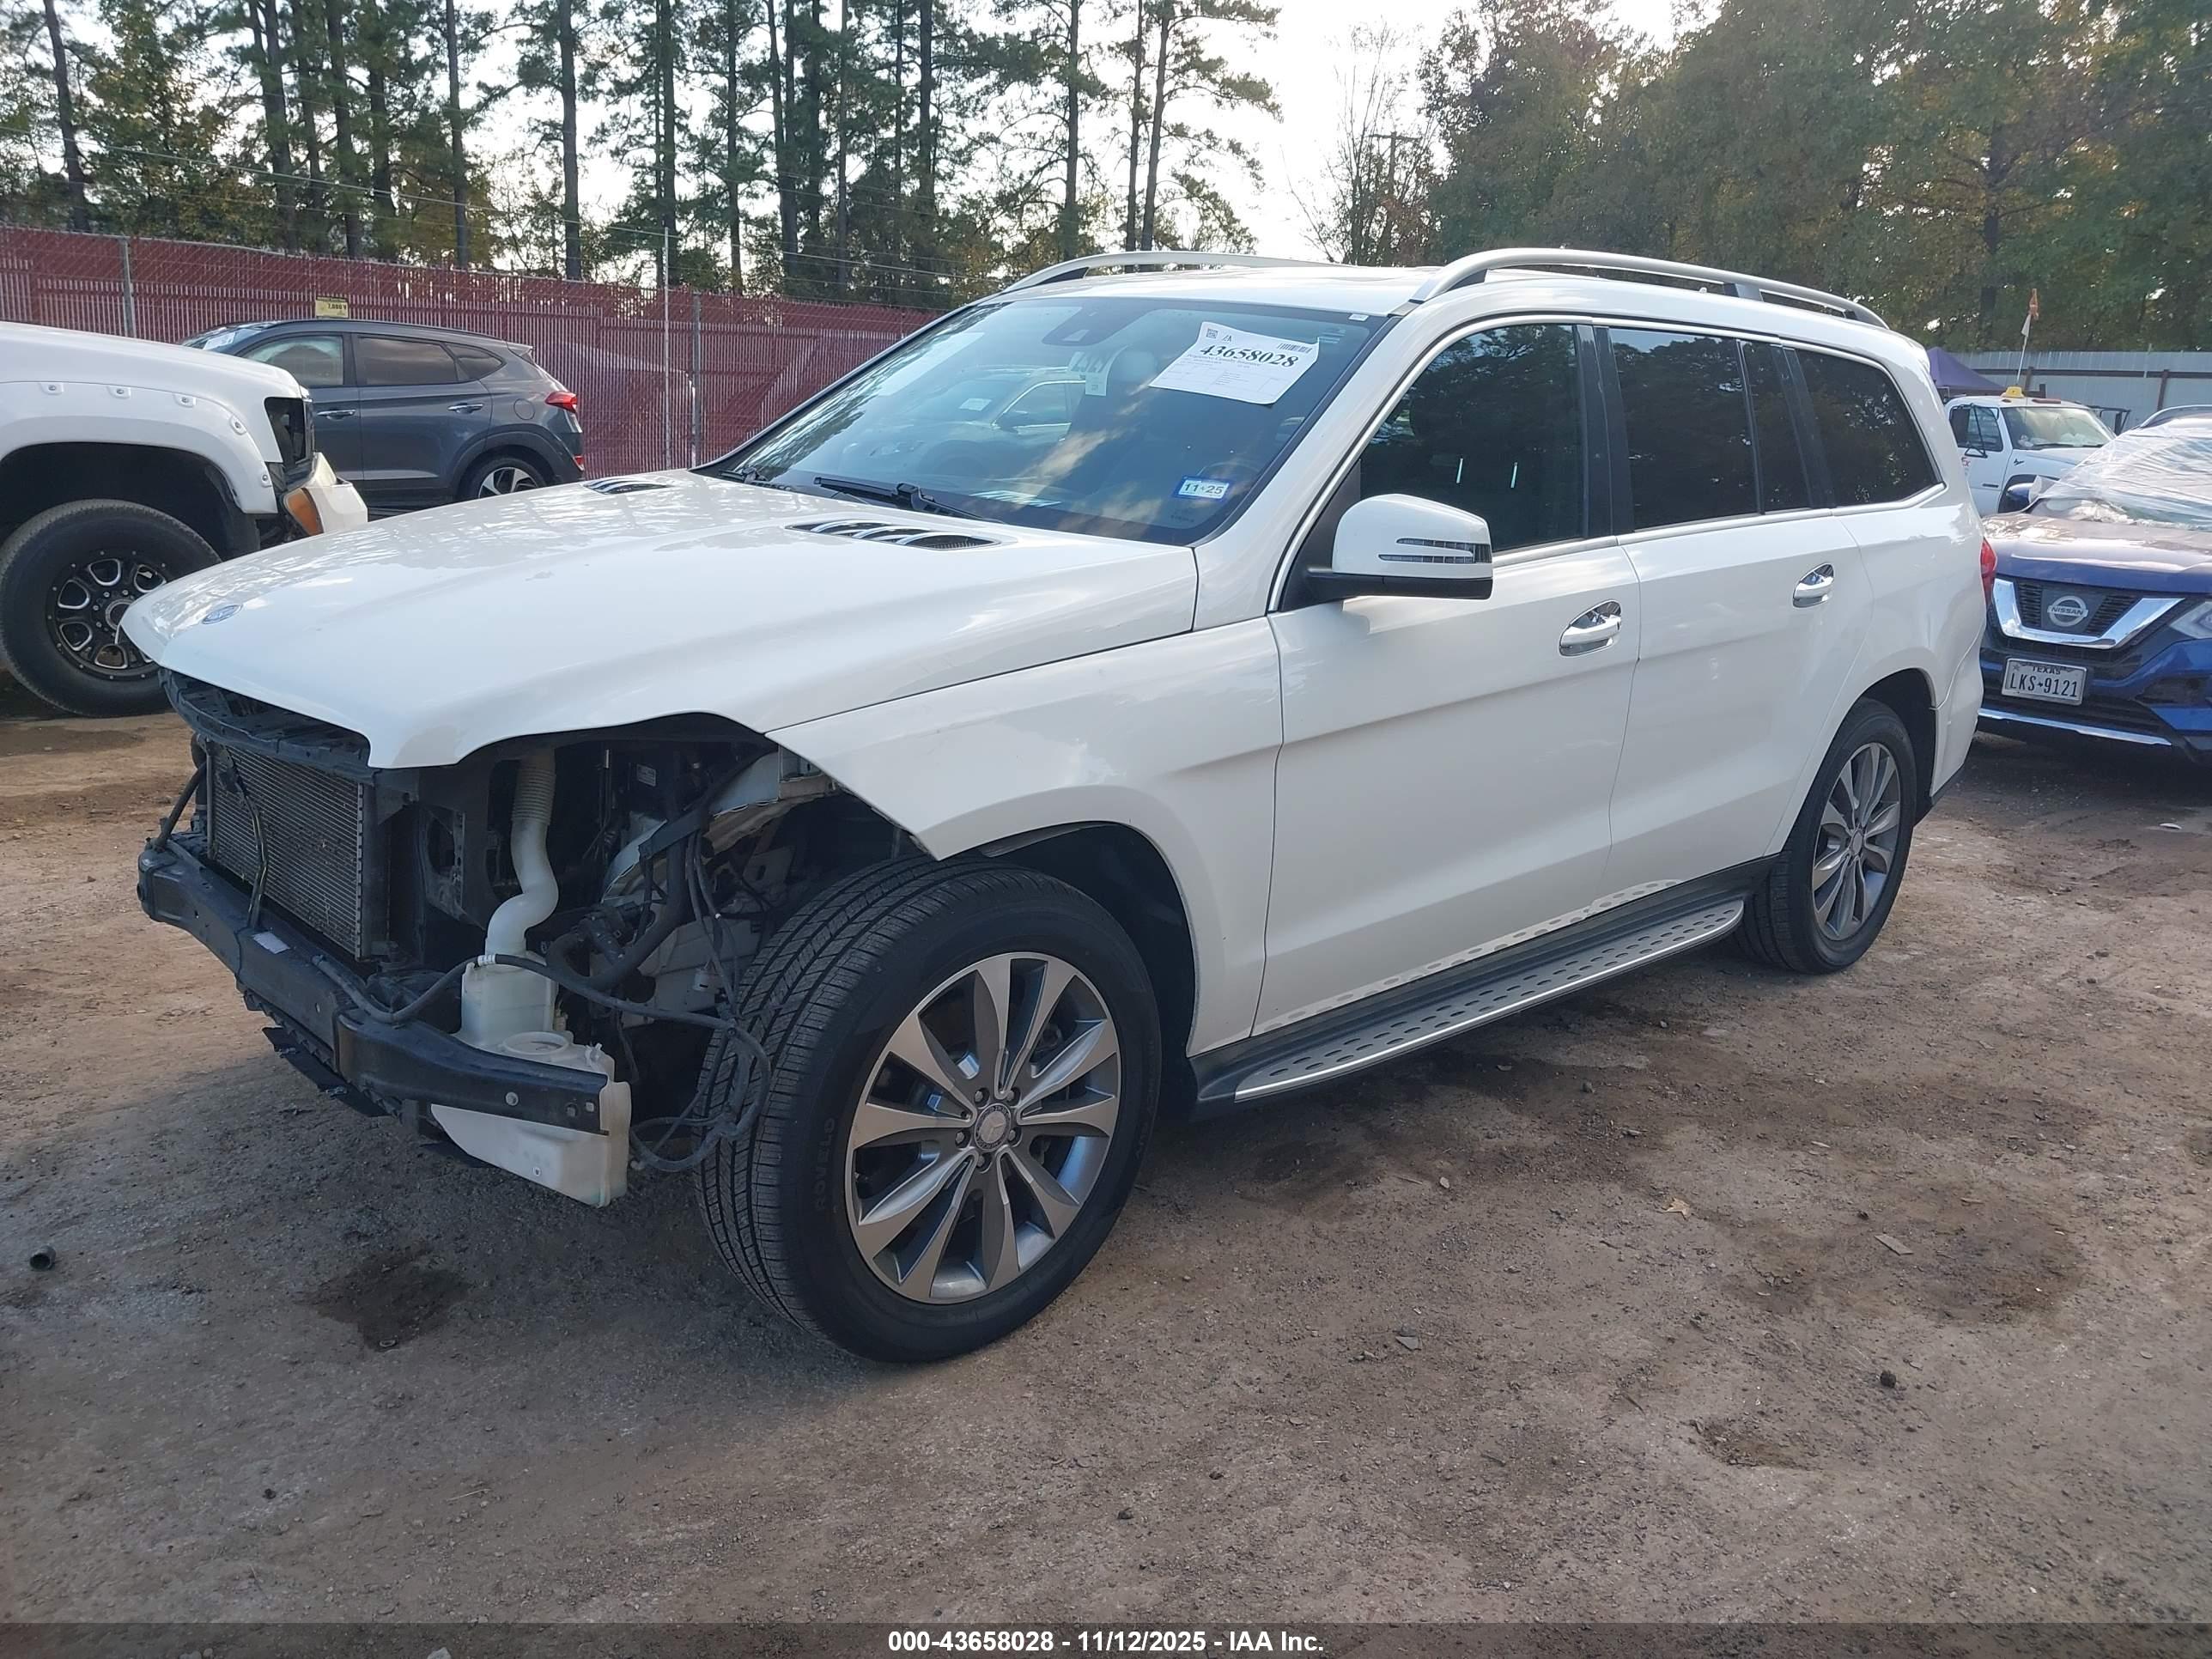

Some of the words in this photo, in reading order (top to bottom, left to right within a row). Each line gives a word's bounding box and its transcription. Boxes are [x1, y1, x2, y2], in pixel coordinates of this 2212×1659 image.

[1200, 344, 1299, 368] 43658028
[2051, 605, 2084, 617] NISSAN
[2033, 665, 2061, 675] TEXAS
[815, 1117, 836, 1206] ROVELO
